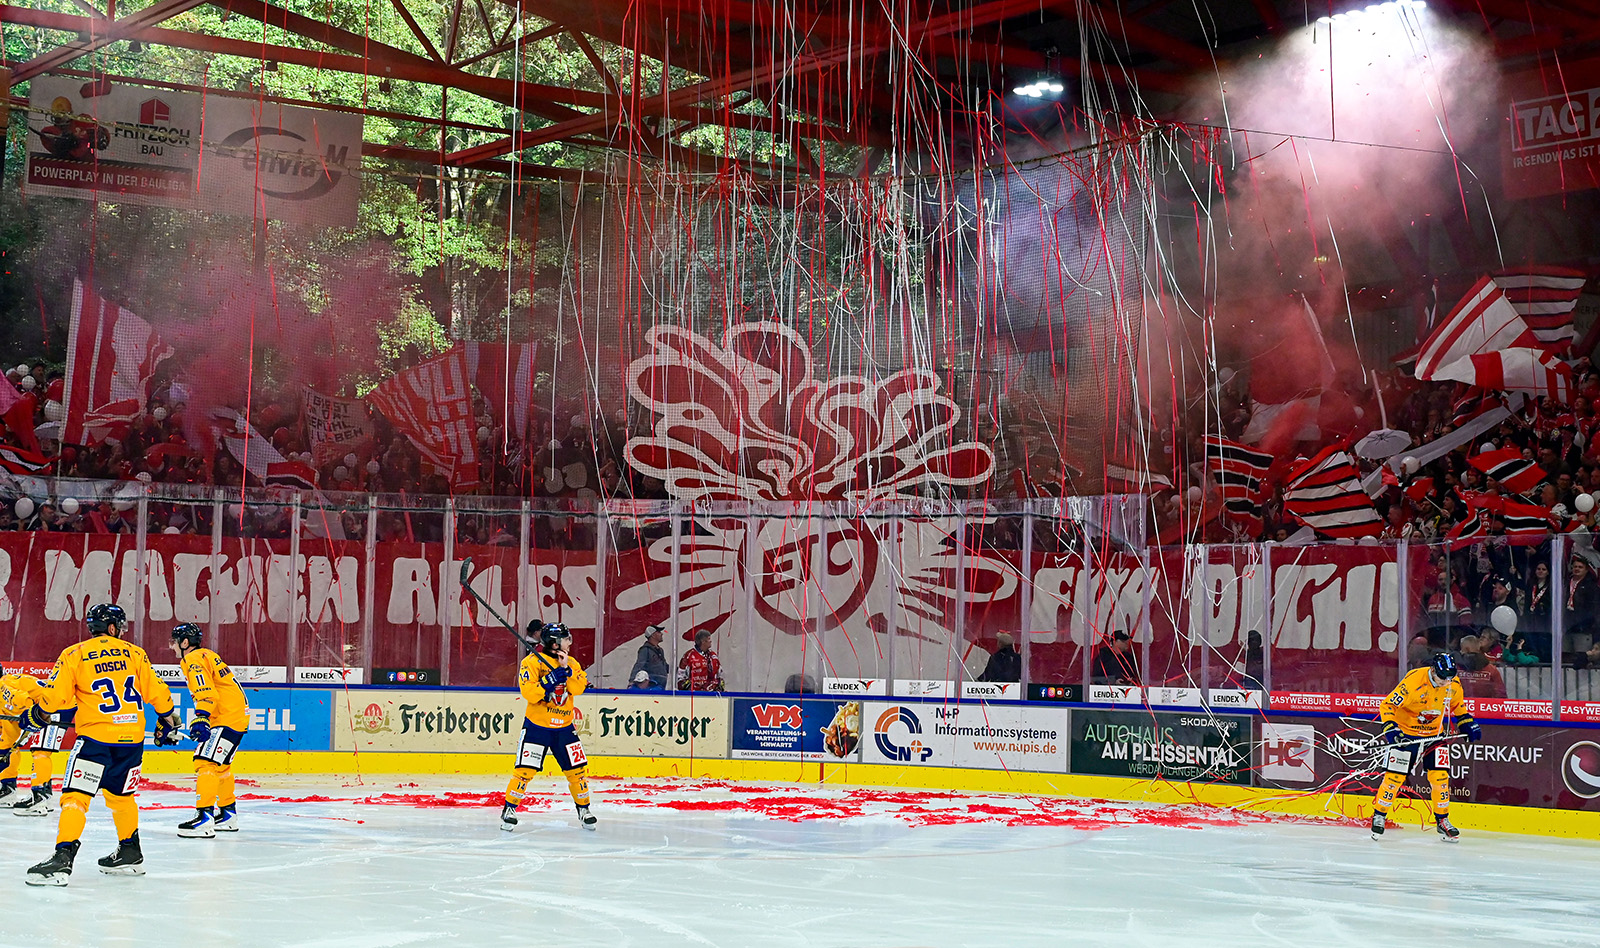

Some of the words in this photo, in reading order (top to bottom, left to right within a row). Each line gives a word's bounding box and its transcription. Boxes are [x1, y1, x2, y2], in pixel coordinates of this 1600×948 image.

[115, 122, 190, 145] FRITZSCH
[141, 145, 163, 156] BAU
[1513, 149, 1576, 168] IRGENDWAS
[1579, 146, 1594, 157] IST
[34, 166, 99, 182] POWERPLAY
[103, 173, 114, 185] IN
[117, 175, 138, 186] DER
[44, 549, 358, 624] MACHEN
[94, 660, 127, 674] DOSCH
[301, 672, 334, 680] LENDEX
[91, 675, 143, 713] 34
[967, 687, 996, 695] LENDEX
[1094, 691, 1119, 699] LENDEX
[1213, 695, 1239, 703] LENDEX
[1270, 696, 1331, 706] EASYWERBUNG
[1480, 703, 1552, 714] EASYWERBUNG
[1389, 692, 1404, 706] 39
[751, 703, 803, 729] VPS
[935, 707, 959, 719] N+P
[399, 703, 514, 741] Freiberger
[599, 707, 711, 744] Freiberger
[1217, 719, 1238, 729] Service
[935, 724, 1057, 742] Informationssysteme
[1085, 724, 1173, 745] AUTOHAUS
[974, 741, 1057, 755] www.nupis.de
[1102, 741, 1128, 760] AM
[1133, 743, 1238, 766] PLEISSENTAL
[1264, 738, 1303, 767] HC
[572, 751, 586, 763] 24
[1438, 755, 1449, 766] 24
[131, 769, 142, 777] TA
[517, 781, 526, 790] 14
[579, 781, 588, 791] 14
[1383, 790, 1394, 800] 39
